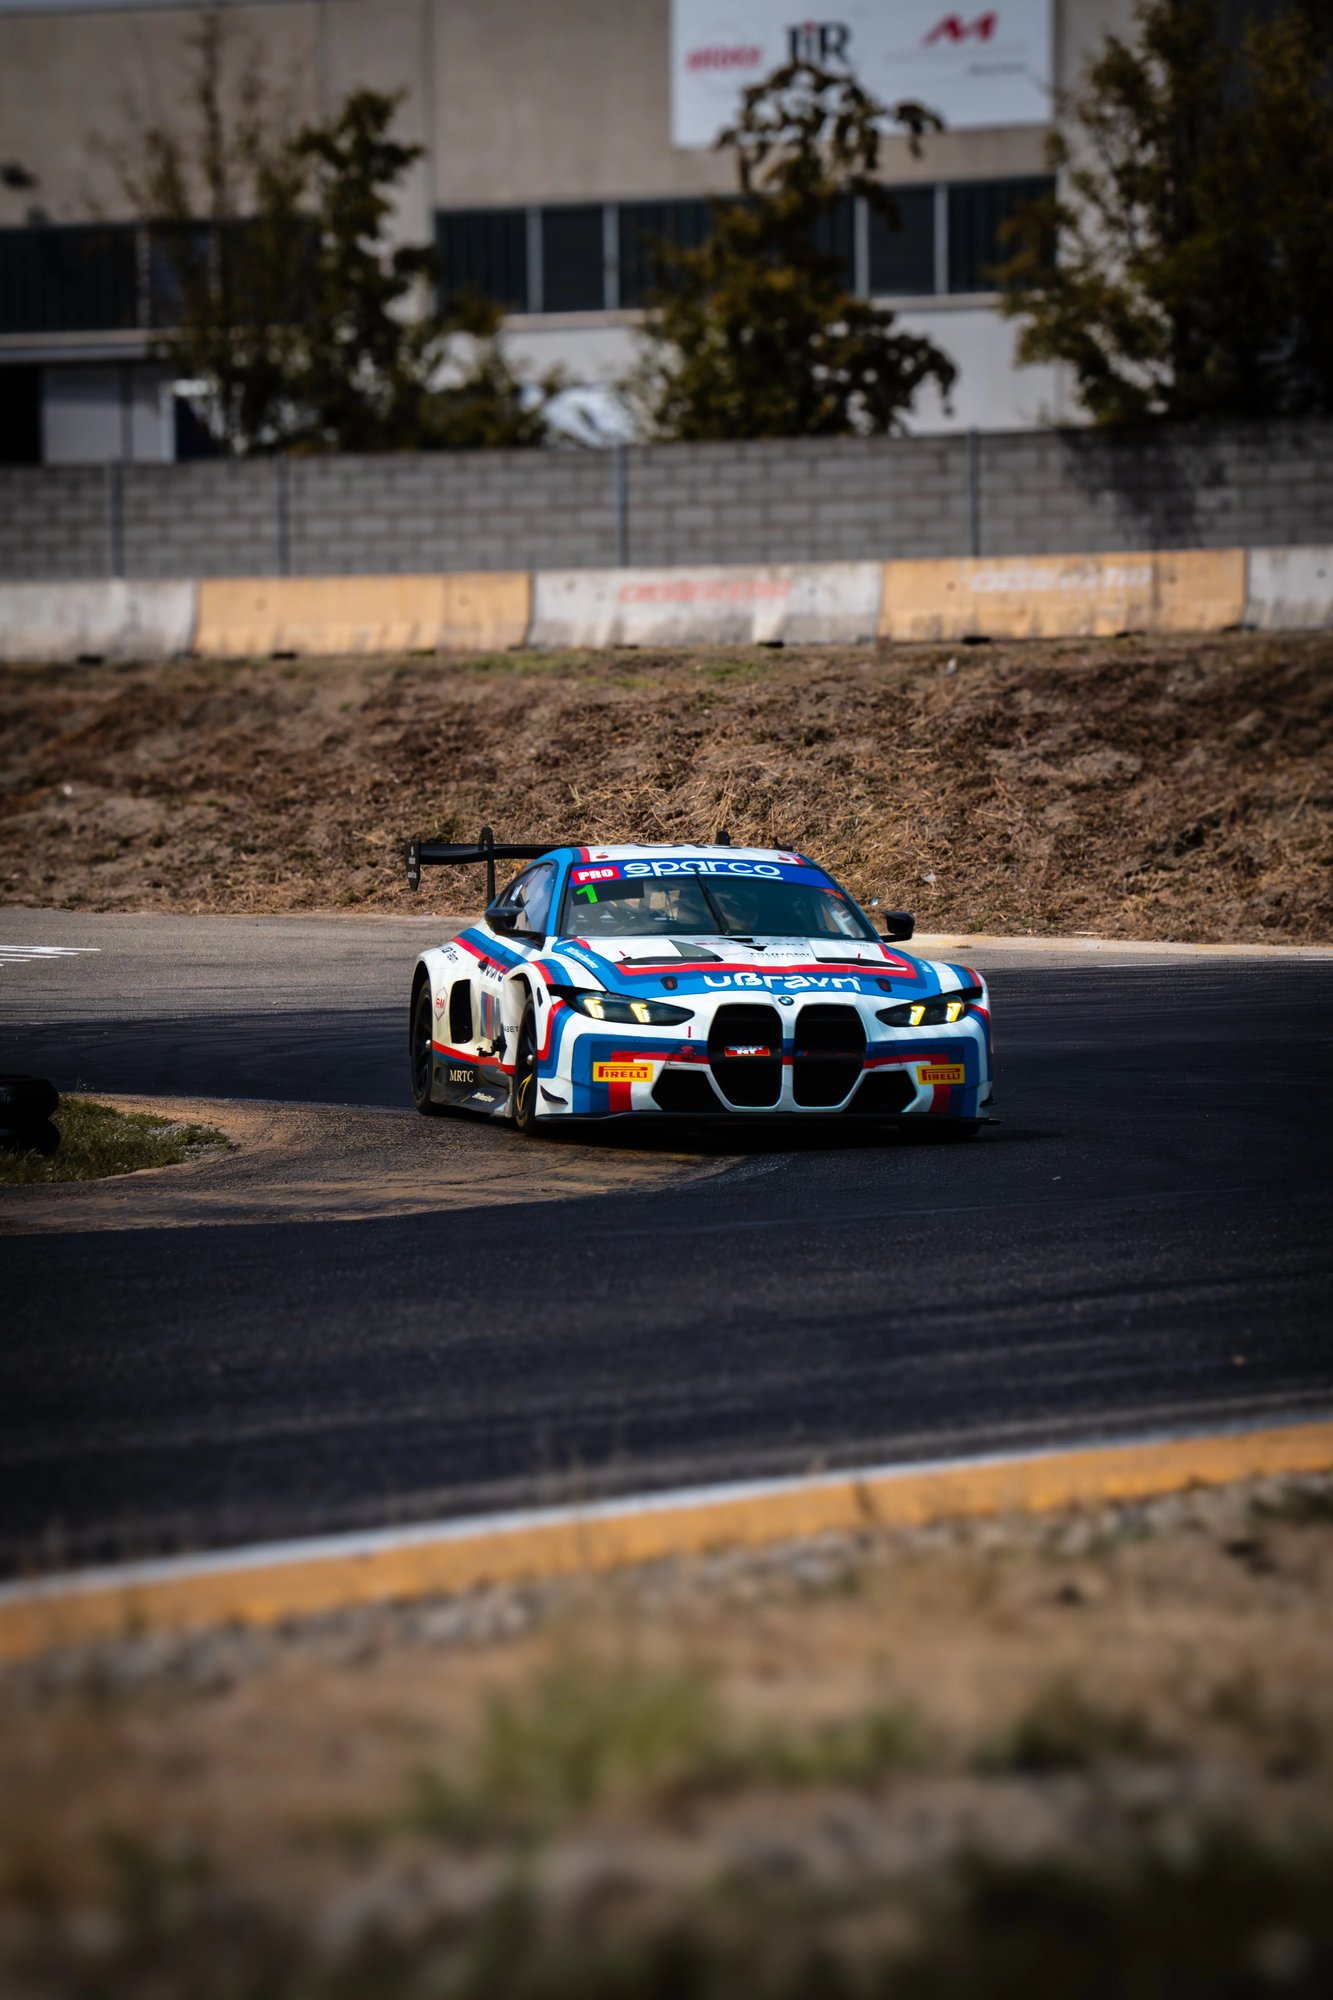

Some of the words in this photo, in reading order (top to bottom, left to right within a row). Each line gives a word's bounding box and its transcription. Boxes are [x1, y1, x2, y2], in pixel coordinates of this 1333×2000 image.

[577, 868, 614, 881] PRO
[623, 860, 783, 880] sparco
[576, 884, 598, 904] 1
[449, 1069, 474, 1083] MRTC
[598, 1065, 648, 1078] PIRELLI
[921, 1068, 961, 1081] PIRELLI
